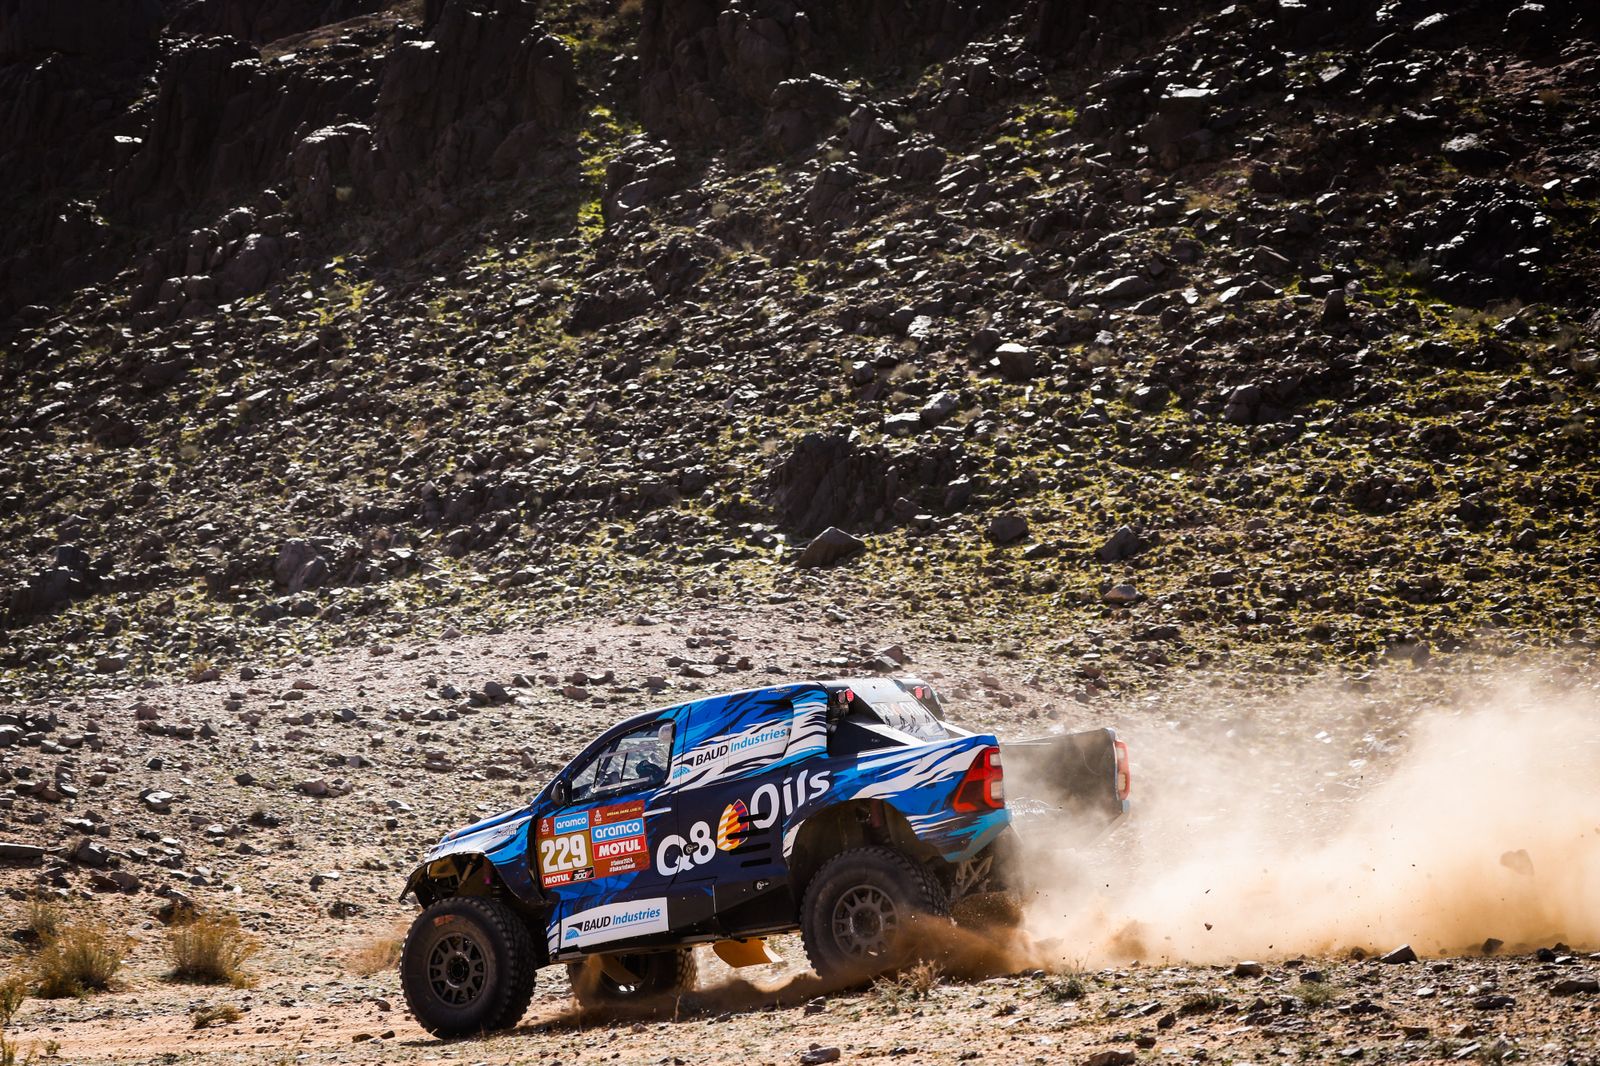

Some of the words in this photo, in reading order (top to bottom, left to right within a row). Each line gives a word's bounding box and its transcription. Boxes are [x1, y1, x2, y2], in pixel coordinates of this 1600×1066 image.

[695, 744, 729, 766] BAUD
[730, 728, 786, 753] Industries
[556, 817, 587, 829] aramco
[595, 822, 641, 839] aramco
[656, 820, 717, 876] Q8
[750, 769, 831, 830] Oils
[541, 834, 588, 874] 229
[598, 839, 641, 857] MOTUL
[545, 873, 571, 885] MOTUL
[583, 915, 611, 932] BAUD
[612, 907, 661, 925] Industries
